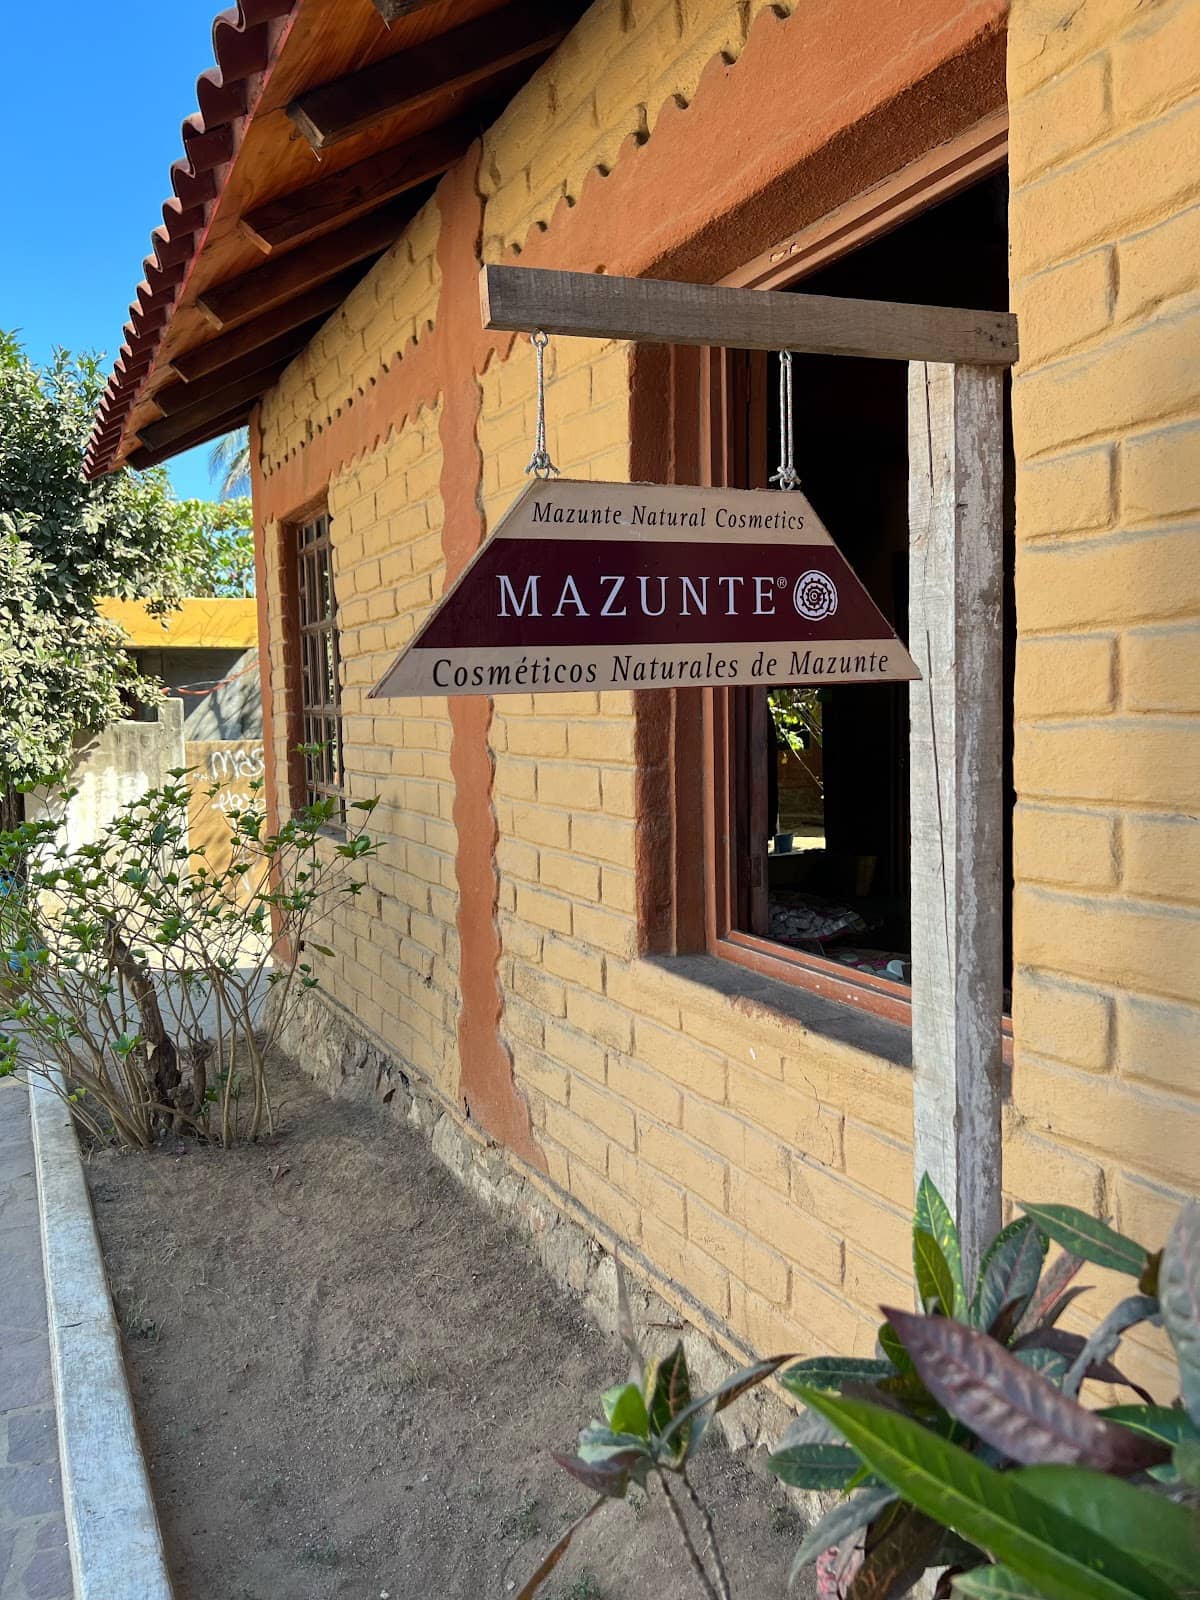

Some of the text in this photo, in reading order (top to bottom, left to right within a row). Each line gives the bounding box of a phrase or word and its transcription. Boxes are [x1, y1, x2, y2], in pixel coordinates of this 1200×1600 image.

[532, 501, 805, 531] Mazunte Natural Cosmetics
[432, 650, 890, 689] Cosméticos Naturales de Mazunte
